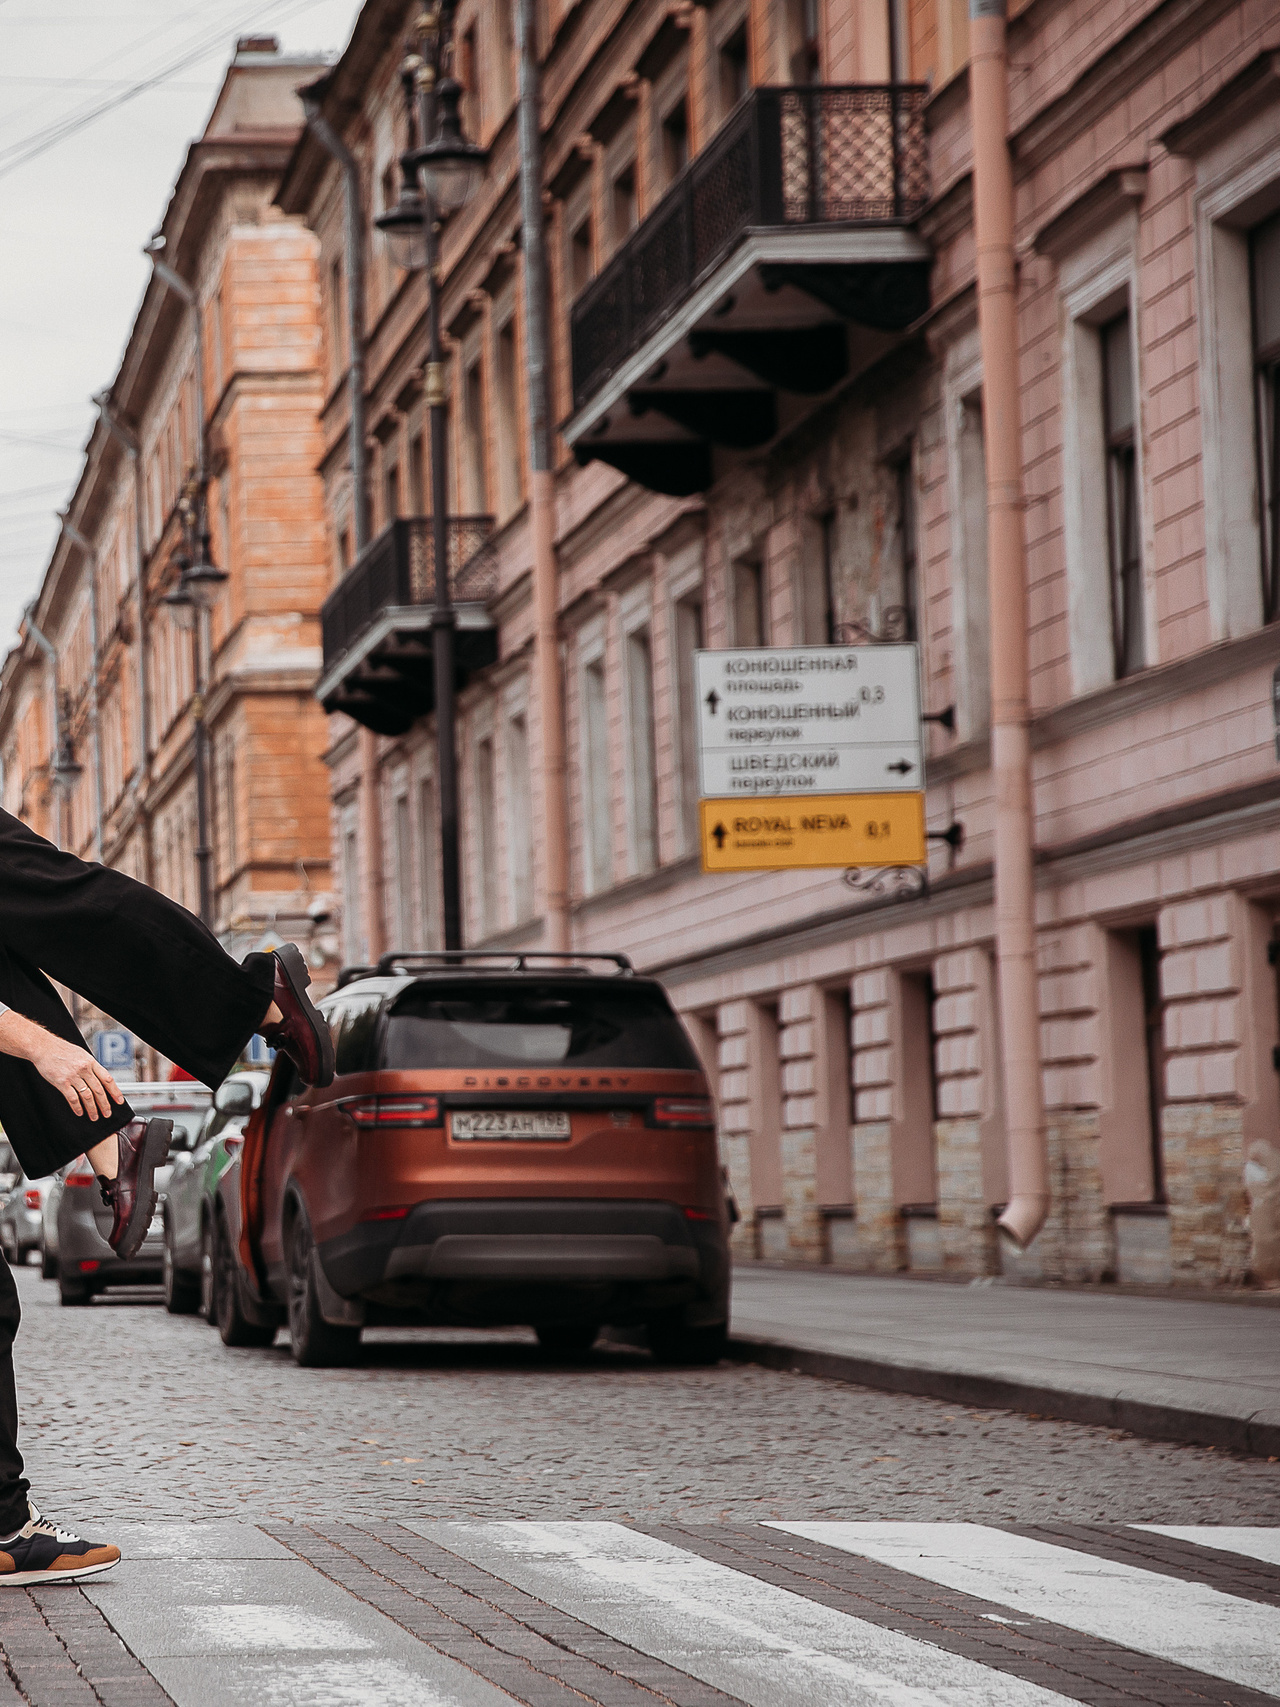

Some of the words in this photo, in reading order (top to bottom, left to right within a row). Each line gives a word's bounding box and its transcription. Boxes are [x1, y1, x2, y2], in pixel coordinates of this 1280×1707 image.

[725, 655, 858, 674] КОНЮШЕННАЯ
[726, 678, 803, 694] площадь
[726, 701, 861, 721] КОНЮШЕННЫЙ
[728, 725, 803, 744] переулок
[730, 749, 840, 771] ШВЕДСКИЙ
[730, 773, 816, 795] переулок
[734, 817, 795, 833] ROYAL
[800, 814, 851, 831] NEVA
[464, 1076, 631, 1088] DISCOVERY
